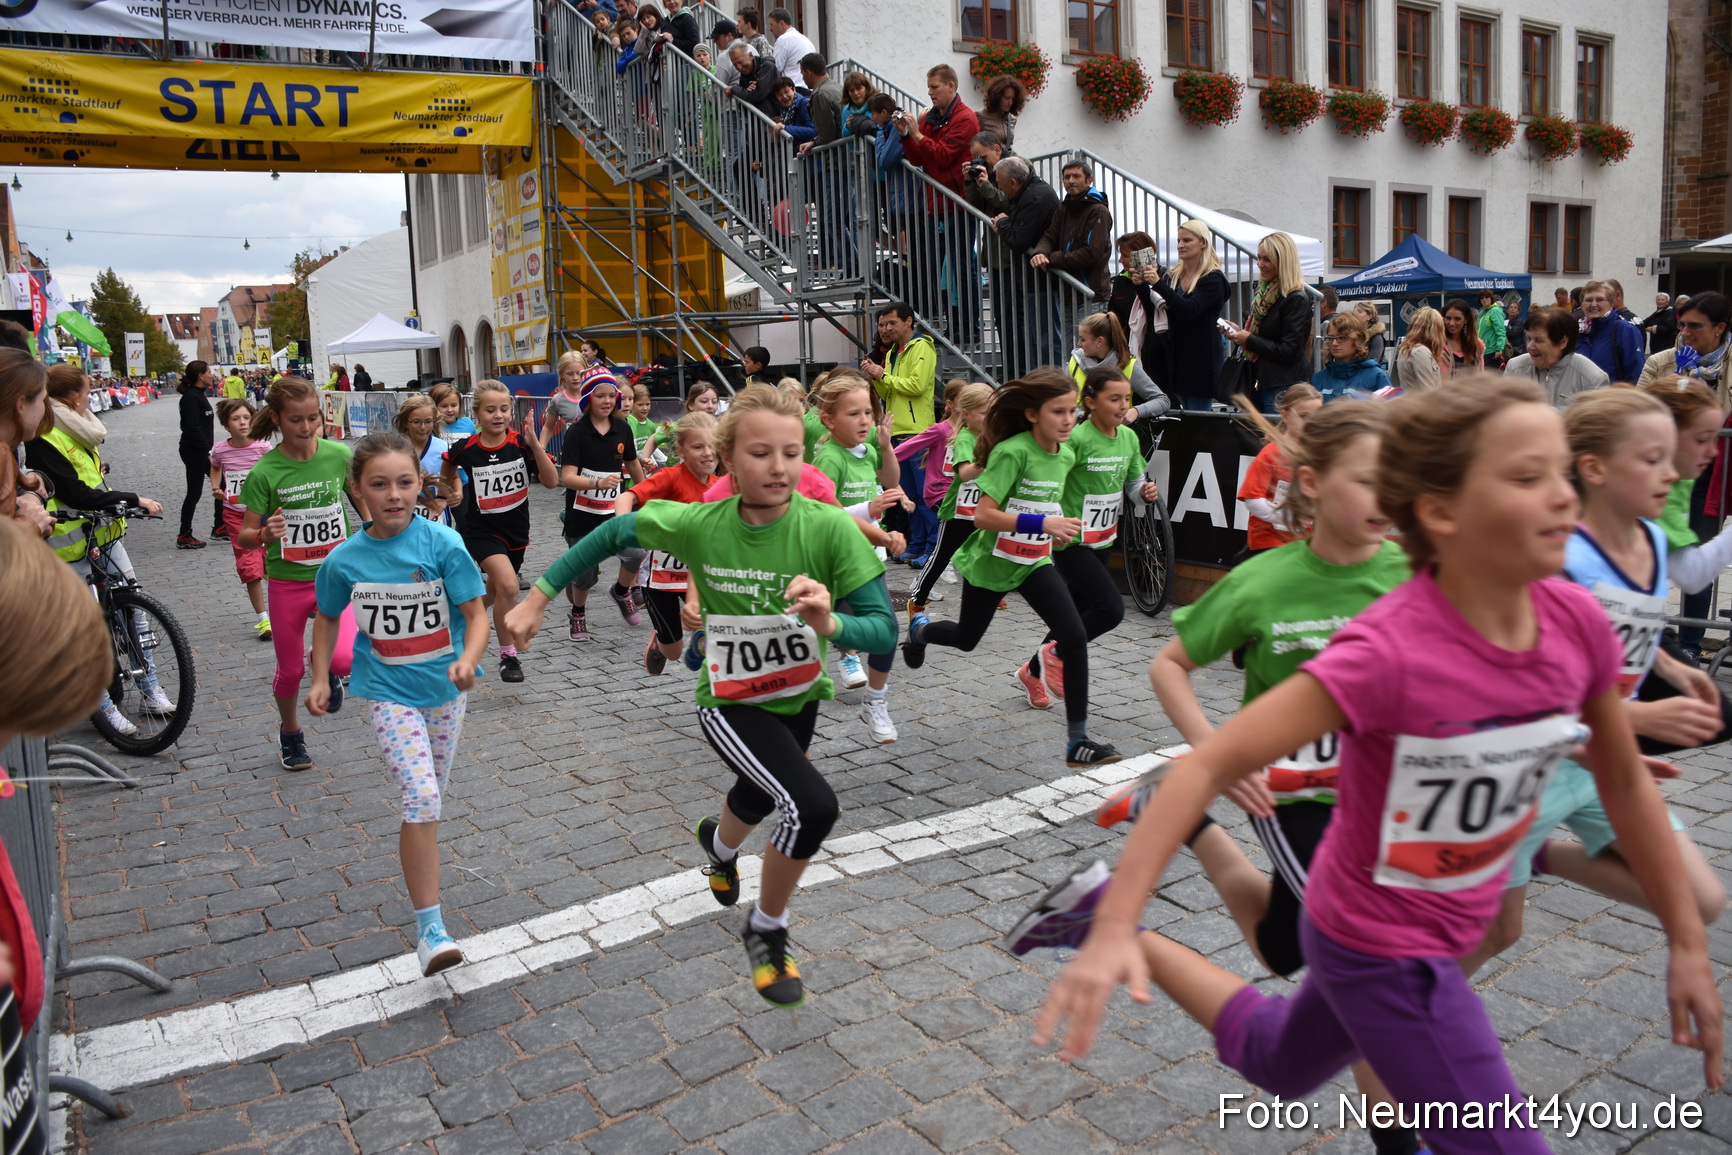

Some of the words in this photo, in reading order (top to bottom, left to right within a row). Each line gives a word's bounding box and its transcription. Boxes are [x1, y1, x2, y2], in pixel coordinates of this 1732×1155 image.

[296, 0, 407, 20] DYNAMCS.
[194, 10, 281, 27] VERBRAUCH.
[284, 17, 321, 29] MEHR
[62, 96, 122, 110] Stadtlauf
[159, 77, 359, 127] START
[393, 111, 454, 122] Neumarkter
[456, 112, 504, 123] Stadtlauf
[1374, 282, 1409, 295] Tagblatt
[1464, 277, 1494, 289] Neumarkter
[261, 352, 269, 362] A
[277, 481, 323, 496] Neumarkter
[479, 471, 525, 496] 7429
[279, 490, 316, 503] Stadtlauf
[305, 511, 336, 521] Neumarkt
[1008, 503, 1032, 514] PARTL
[287, 517, 342, 545] 7085
[305, 547, 329, 558] Lucia
[661, 550, 689, 570] 70
[702, 564, 777, 582] Neumarkter
[704, 577, 761, 598] Stadtlauf
[353, 591, 384, 600] PARTL
[386, 590, 431, 601] Neumarkt
[362, 600, 442, 636] 7575
[709, 623, 738, 635] PARTL
[740, 622, 793, 636] Neumarkt
[716, 632, 810, 675] 7046
[751, 677, 788, 694] Lena
